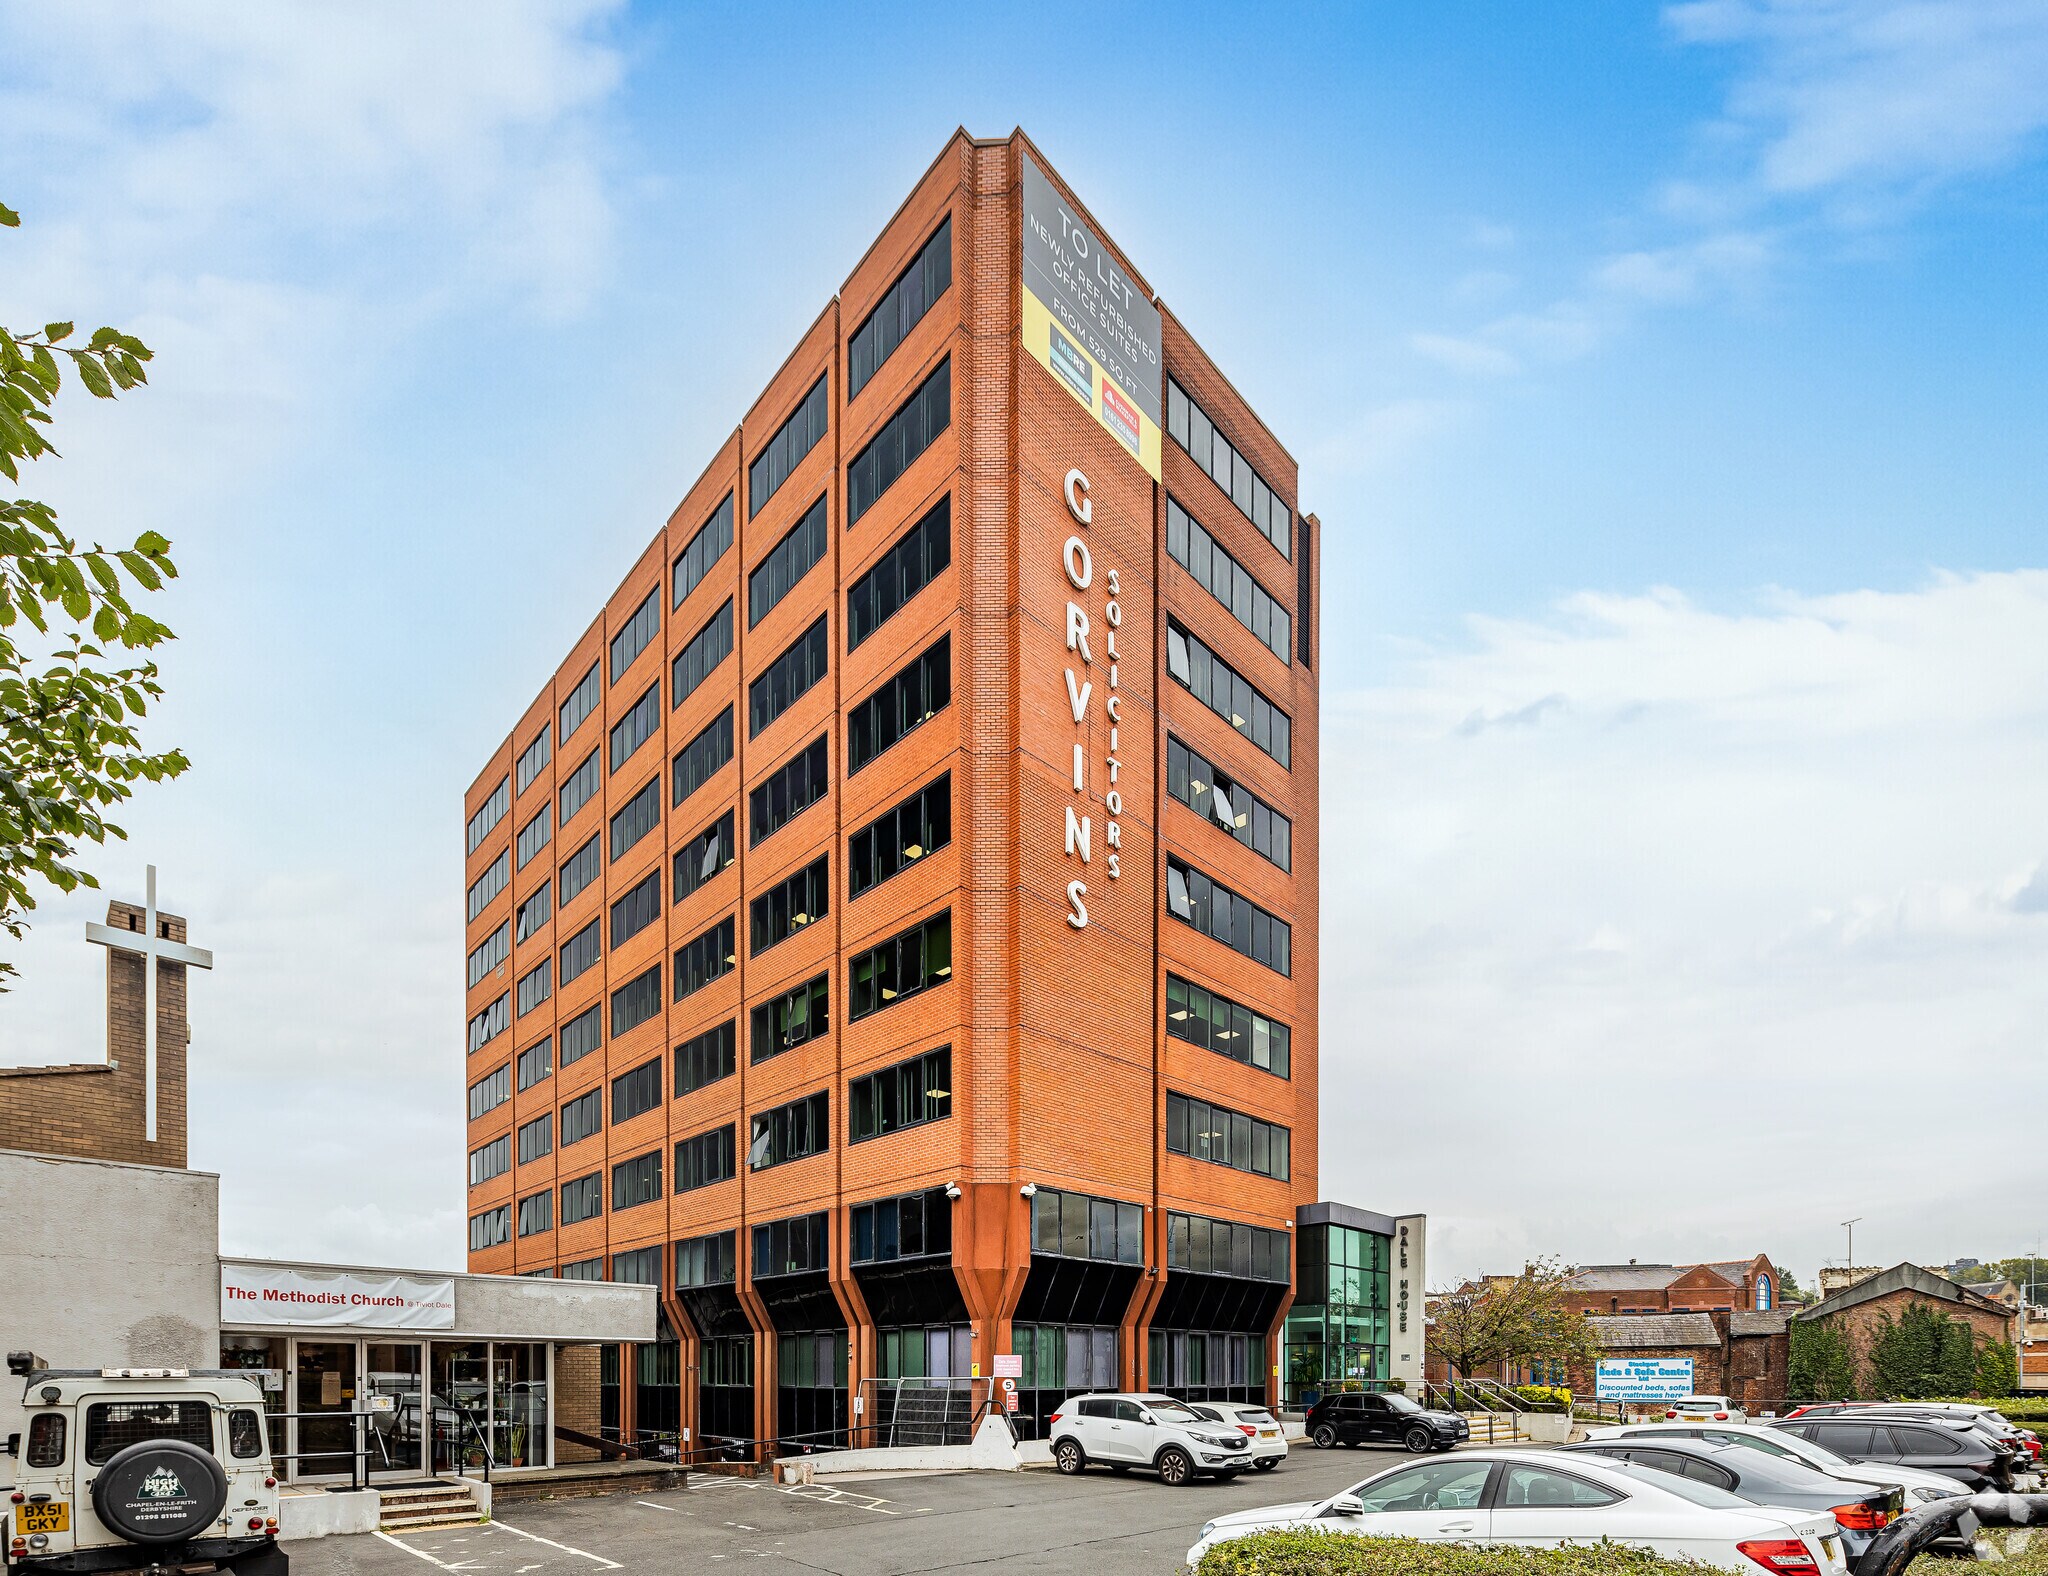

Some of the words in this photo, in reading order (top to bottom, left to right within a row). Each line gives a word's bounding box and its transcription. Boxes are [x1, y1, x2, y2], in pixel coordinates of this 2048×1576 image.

[1058, 207, 1089, 259] TO
[1097, 253, 1133, 310] LET
[1030, 213, 1074, 271] NEWLY
[1078, 268, 1157, 365] REFURBISHED
[1053, 261, 1097, 318] OFFICE
[1100, 312, 1138, 363] SUITES
[1053, 297, 1086, 341] FROM
[1088, 335, 1107, 361] 529
[1109, 358, 1124, 383] SQ
[1125, 375, 1138, 395] FT
[1058, 337, 1086, 375] MBRE
[1063, 468, 1093, 929] GORVINS
[1105, 569, 1122, 879] SOLICITORS
[1400, 1225, 1409, 1268] DALE
[225, 1286, 257, 1300] The
[263, 1288, 347, 1305] Methodist
[350, 1293, 404, 1307] Church
[435, 1301, 452, 1309] Dale
[1400, 1279, 1409, 1333] HOUSE
[1005, 1381, 1012, 1390] 5
[1599, 1368, 1622, 1376] Beds
[1625, 1368, 1631, 1376] &
[1634, 1368, 1656, 1376] Sofa
[1658, 1368, 1691, 1376] Centre
[144, 1484, 179, 1492] PEAK
[145, 1478, 178, 1486] HIGH
[24, 1504, 62, 1517] BX51
[126, 1500, 197, 1508] CHAPEL-EN-LE-FRITH
[27, 1517, 59, 1530] GKY
